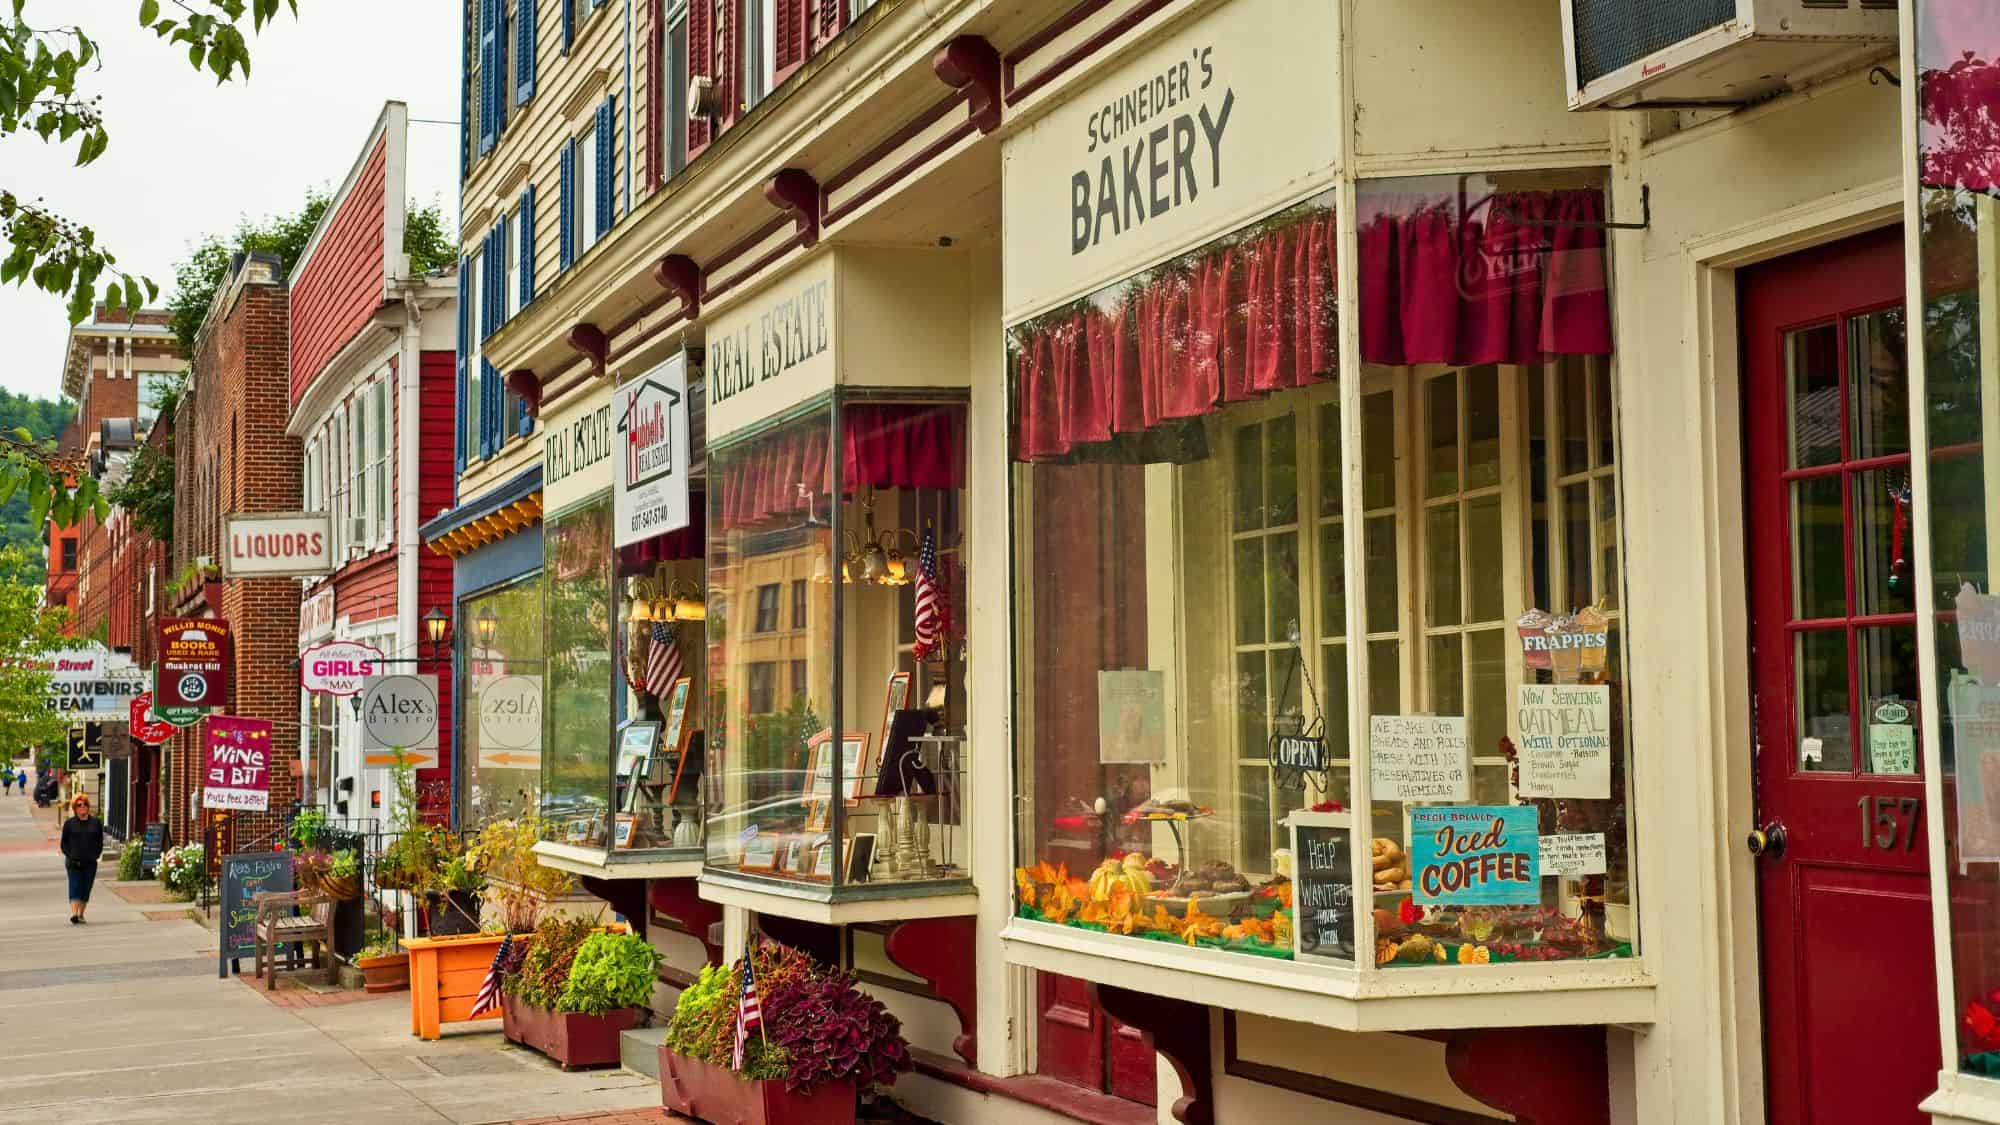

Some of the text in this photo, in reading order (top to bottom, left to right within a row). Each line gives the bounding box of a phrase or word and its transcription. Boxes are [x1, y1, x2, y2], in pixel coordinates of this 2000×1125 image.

[1087, 45, 1213, 153] SCHNEIDER'S
[1071, 87, 1236, 256] BAKERY
[711, 279, 829, 406] REAL ESTATE
[545, 403, 612, 487] REAL ESTATE
[233, 531, 322, 560] LIQUORS
[163, 621, 195, 636] WILLIS
[170, 641, 216, 650] BOOKS
[1523, 632, 1607, 651] FRAPPES
[58, 659, 94, 671] Street
[204, 662, 221, 672] Hill
[312, 660, 374, 677] GIRLS
[51, 682, 143, 696] SOUVENIRS
[329, 679, 355, 690] MAY
[45, 697, 95, 712] REAM
[1518, 707, 1606, 735] OATMEAL
[1412, 736, 1433, 750] AND
[1521, 735, 1553, 749] WITH
[1279, 737, 1319, 767] OPEN
[1407, 752, 1438, 767] WITH
[1413, 814, 1446, 823] FRESH
[1857, 795, 1920, 852] 157
[1434, 816, 1508, 858] Iced
[1308, 839, 1336, 870] HELP
[1420, 852, 1532, 899] COFFEE
[1300, 879, 1348, 907] WANTED
